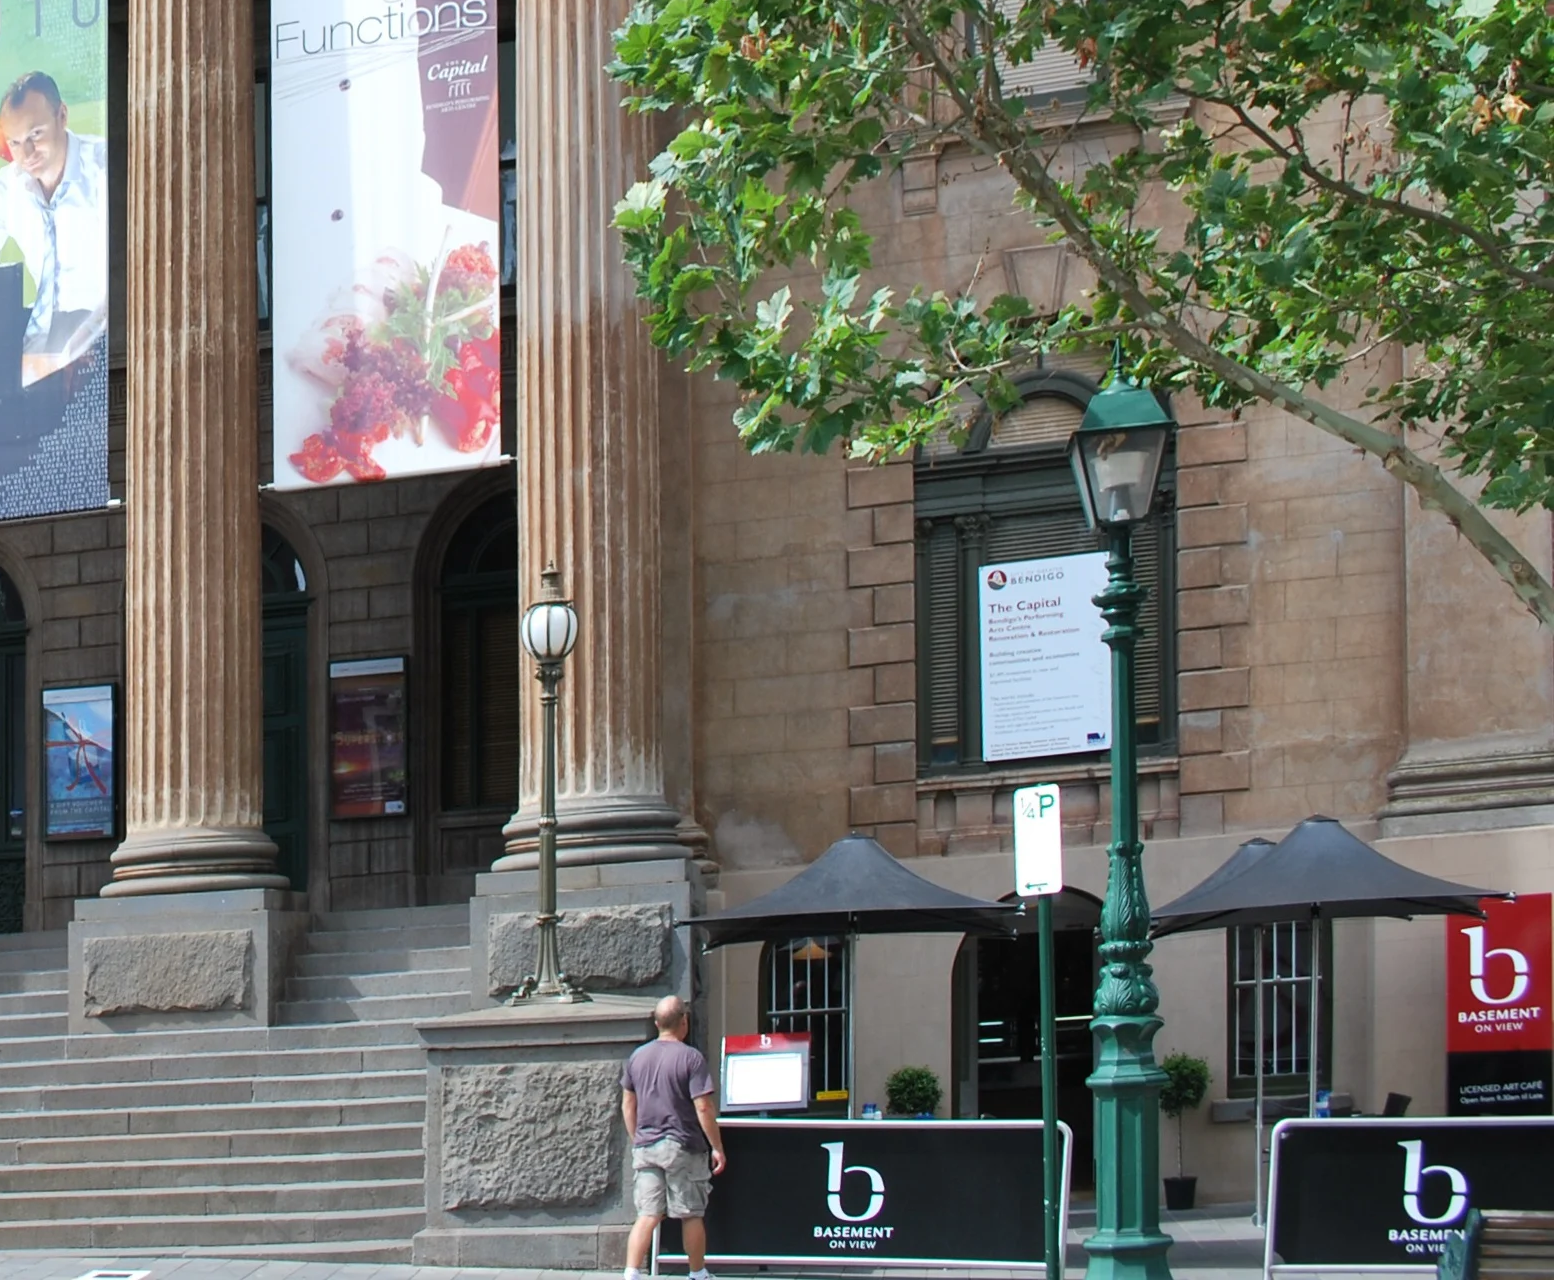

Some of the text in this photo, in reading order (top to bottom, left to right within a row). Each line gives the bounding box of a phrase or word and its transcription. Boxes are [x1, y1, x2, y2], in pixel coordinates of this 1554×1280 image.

[427, 55, 488, 81] Capital
[1010, 571, 1064, 585] BENDIGO
[988, 596, 1061, 614] The Capital
[1460, 925, 1529, 1004] b
[1457, 1007, 1541, 1023] BASEMENT
[1474, 1022, 1523, 1033] ON VIEW
[1459, 1084, 1500, 1094] LICENSED
[1502, 1082, 1519, 1091] ART
[1460, 1096, 1478, 1104] Open
[820, 1141, 885, 1221] b
[1397, 1139, 1467, 1224] b
[813, 1226, 894, 1238] BASEMENT
[829, 1240, 876, 1249] ON VIEW
[1405, 1243, 1446, 1253] ON VIE
